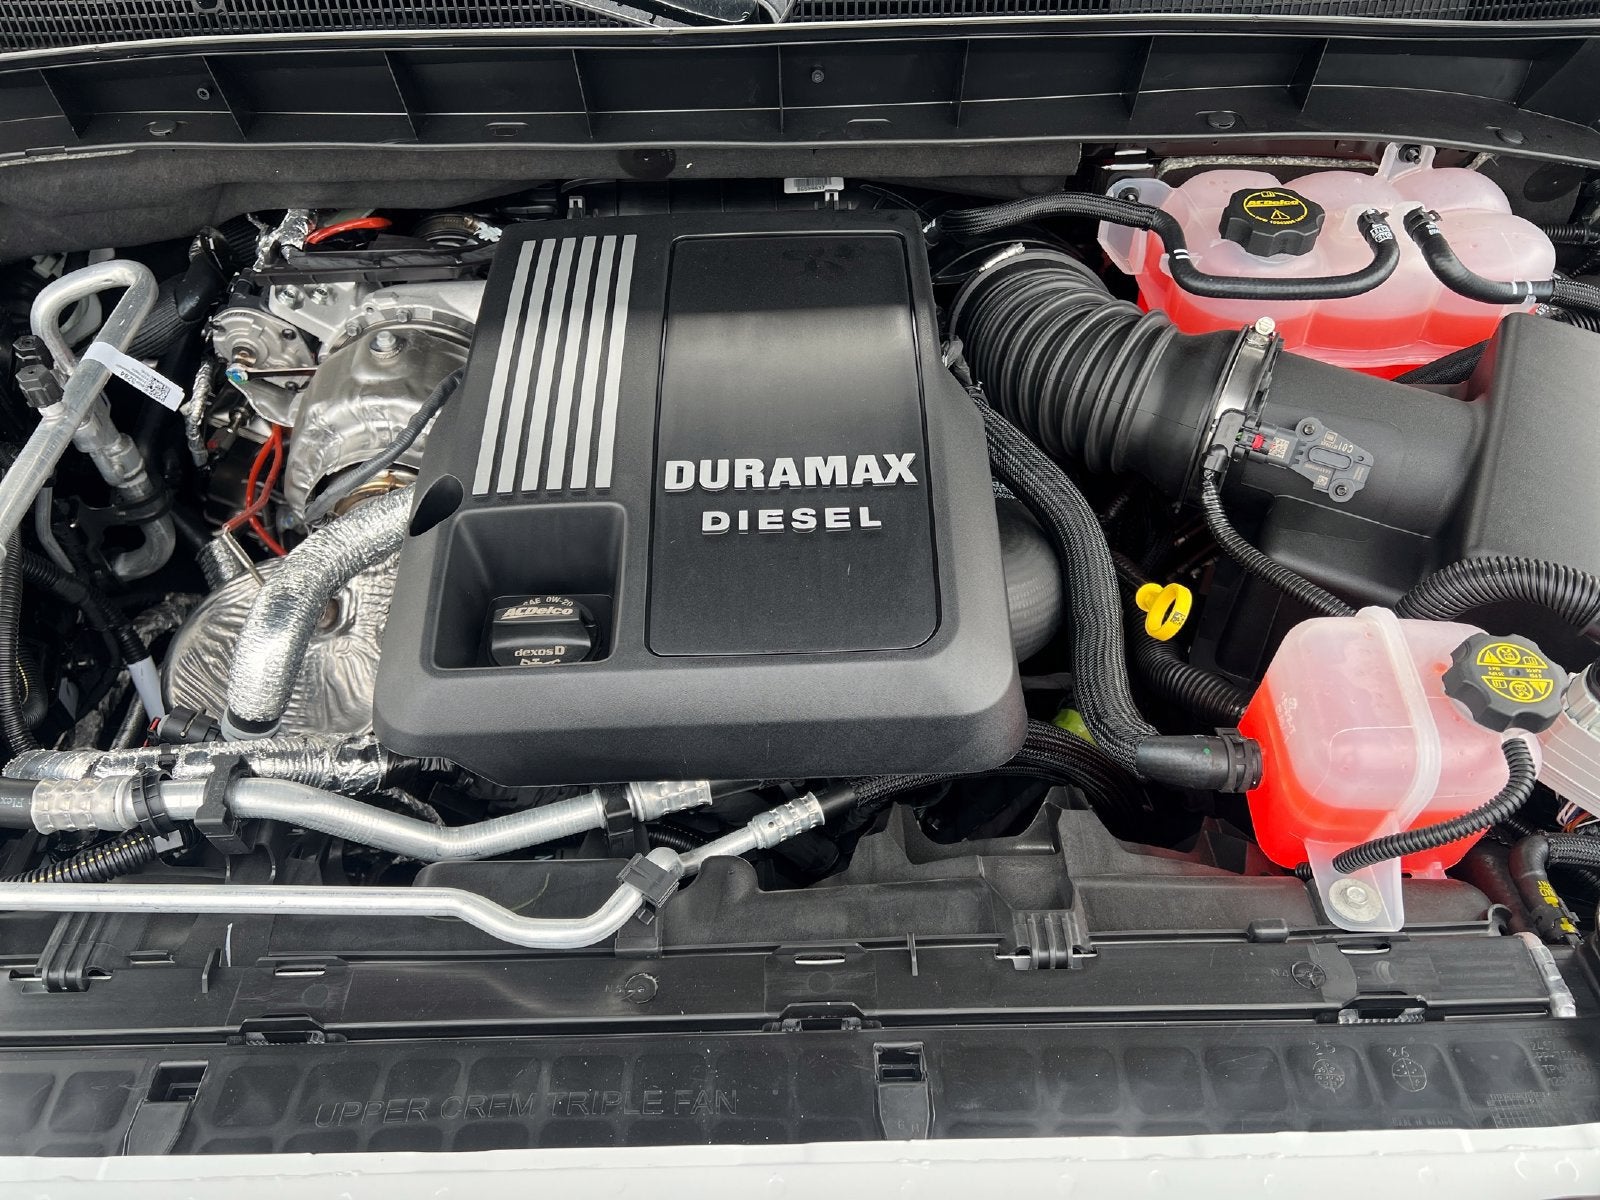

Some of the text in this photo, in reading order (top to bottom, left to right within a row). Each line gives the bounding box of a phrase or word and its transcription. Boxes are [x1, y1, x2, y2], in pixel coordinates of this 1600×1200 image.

[664, 453, 918, 492] DURAMAX
[702, 506, 882, 535] DIESEL
[500, 606, 574, 620] ACDelco
[315, 1097, 430, 1127] UPPER
[547, 1090, 665, 1115] TRIPLE
[674, 1089, 737, 1115] FAN
